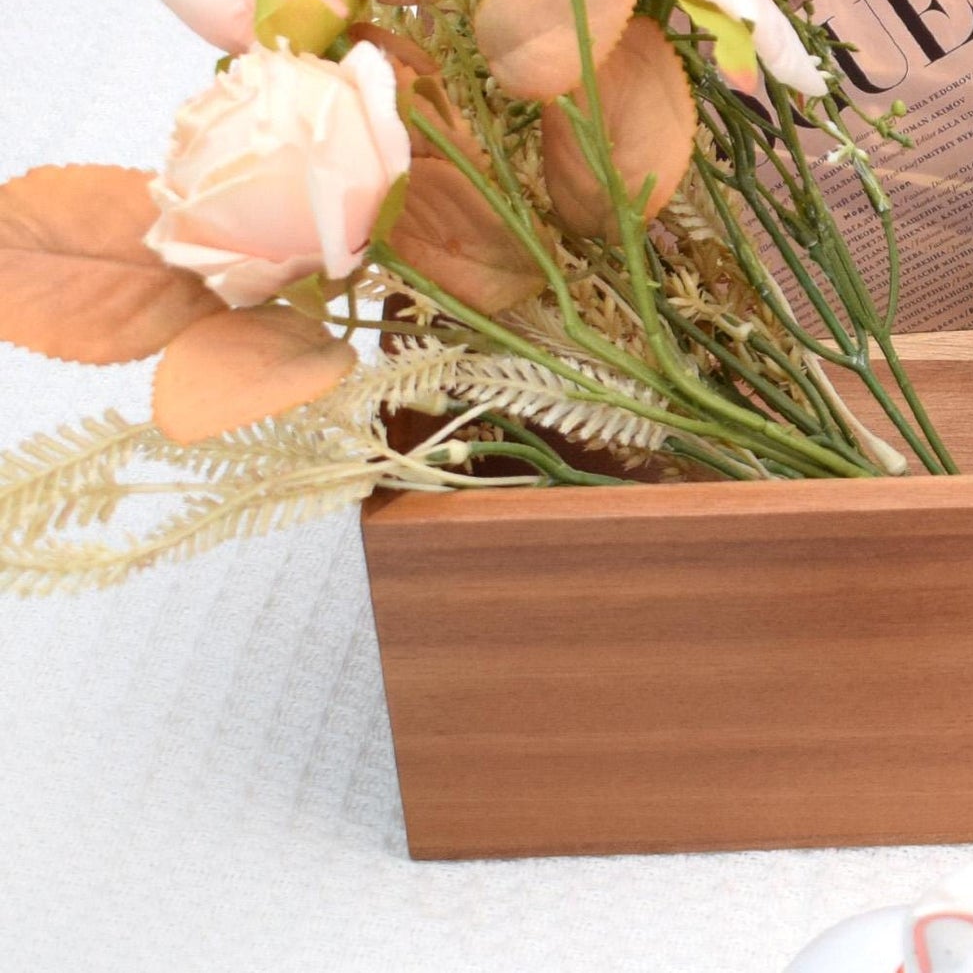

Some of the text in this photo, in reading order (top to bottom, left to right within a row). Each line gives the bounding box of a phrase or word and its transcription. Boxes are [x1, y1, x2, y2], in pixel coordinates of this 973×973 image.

[929, 96, 967, 121] AKIMOV
[936, 117, 960, 134] ALLA
[916, 138, 956, 165] DMITRIY
